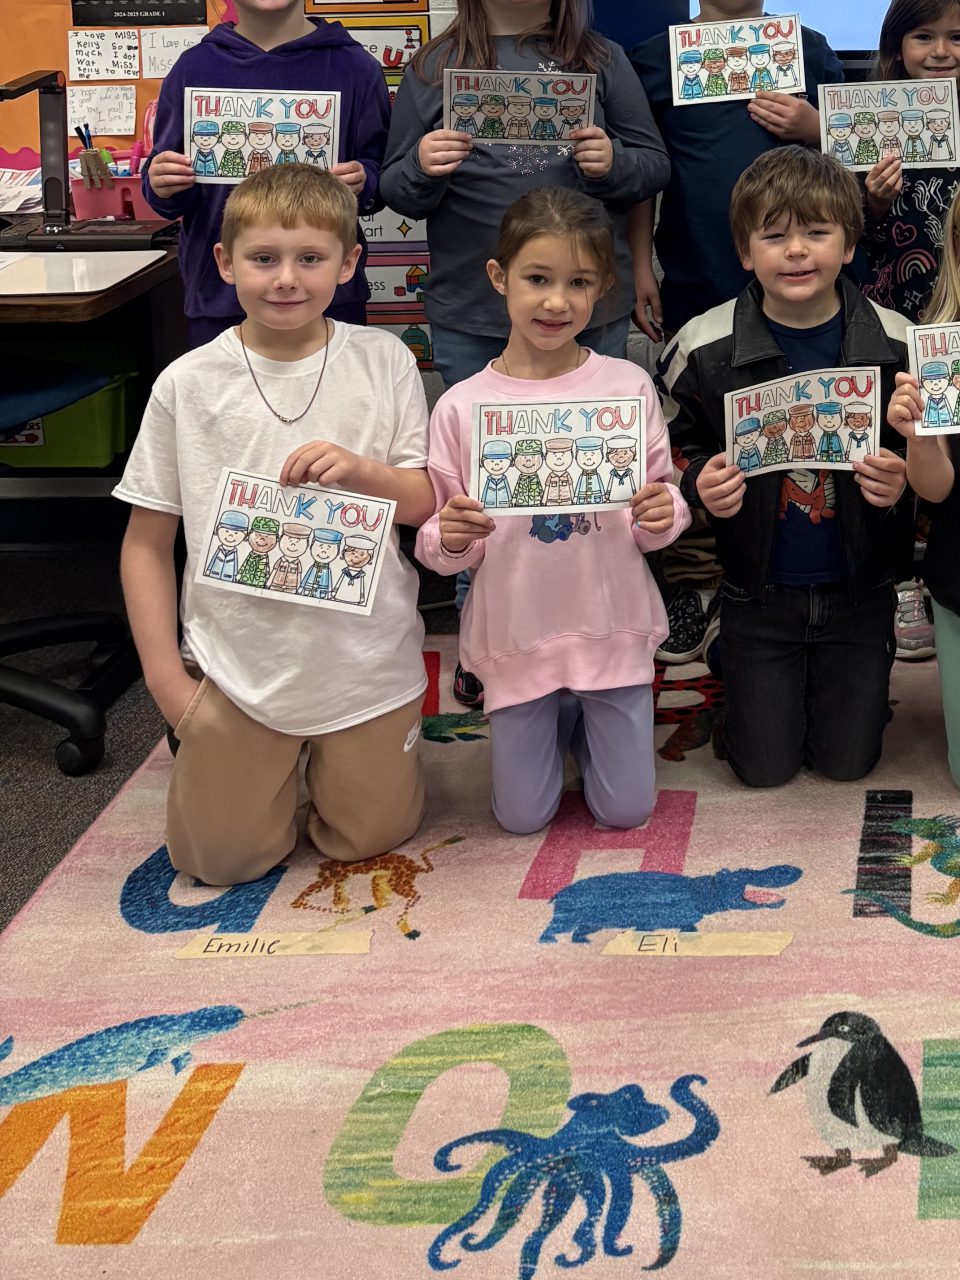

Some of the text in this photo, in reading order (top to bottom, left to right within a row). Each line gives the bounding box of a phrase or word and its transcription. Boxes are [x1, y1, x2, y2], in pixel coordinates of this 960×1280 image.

[678, 19, 794, 48] THANK YOU
[454, 75, 588, 96] THANK YOU
[828, 85, 949, 110] THANK YOU
[193, 94, 332, 119] THANK YOU
[736, 376, 873, 418] THANK YOU
[485, 406, 636, 436] THANK YOU
[228, 479, 384, 532] THANK YOU
[203, 936, 281, 954] Emilie
[638, 934, 678, 952] Eli
